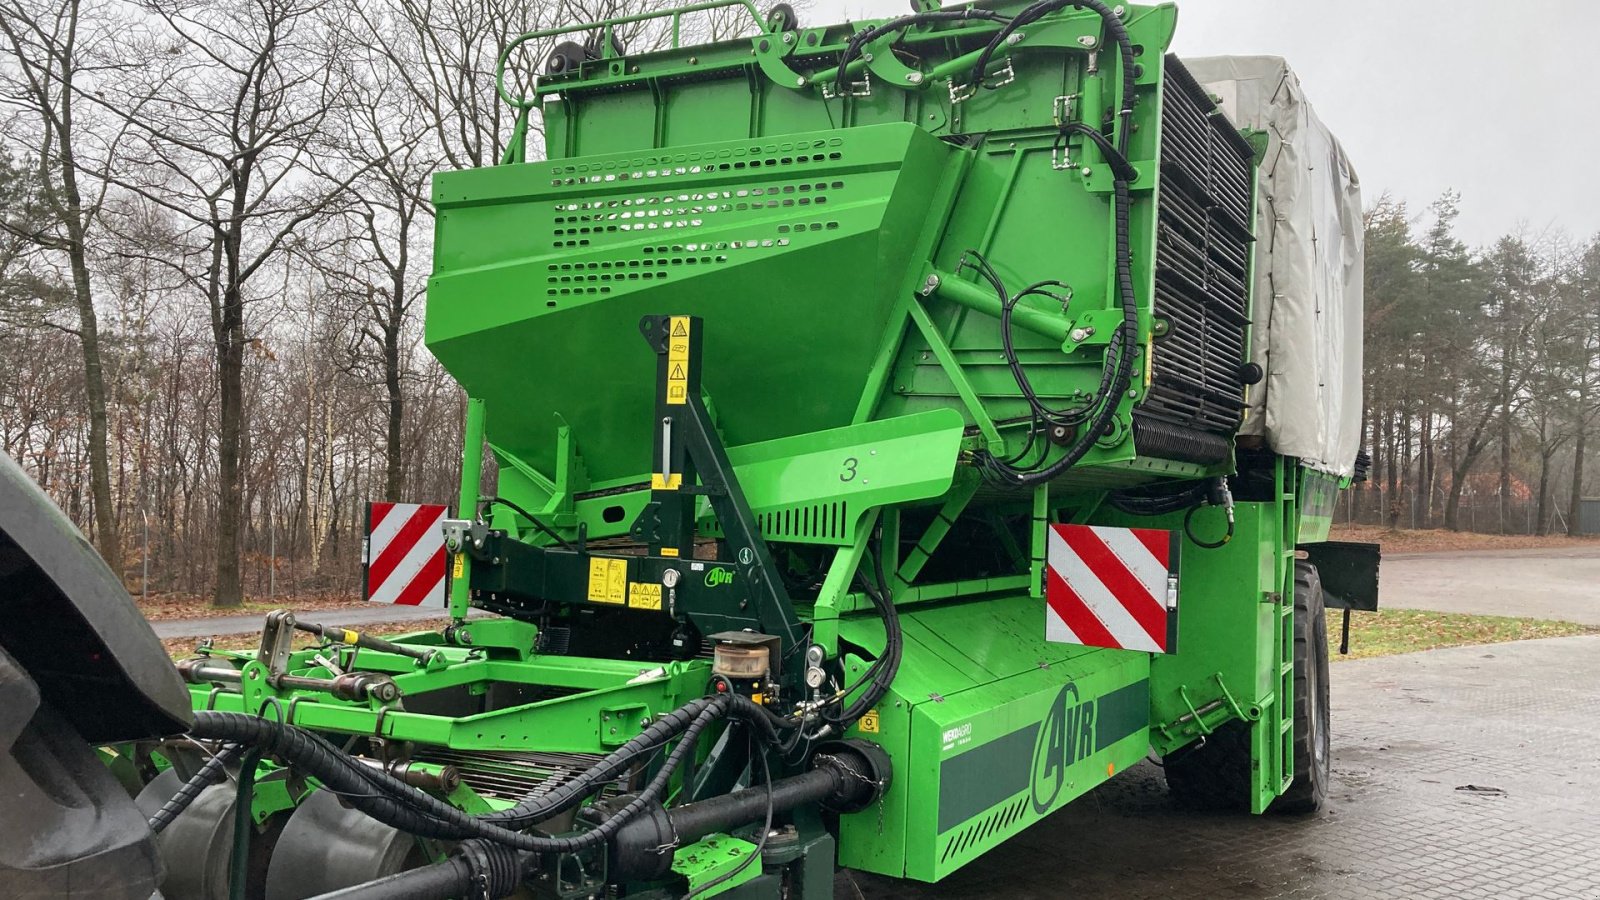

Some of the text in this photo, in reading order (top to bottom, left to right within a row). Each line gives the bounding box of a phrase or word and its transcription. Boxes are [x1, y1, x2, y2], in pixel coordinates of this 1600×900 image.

[840, 458, 858, 482] 3
[704, 567, 733, 587] AVR
[1032, 682, 1094, 814] AVR
